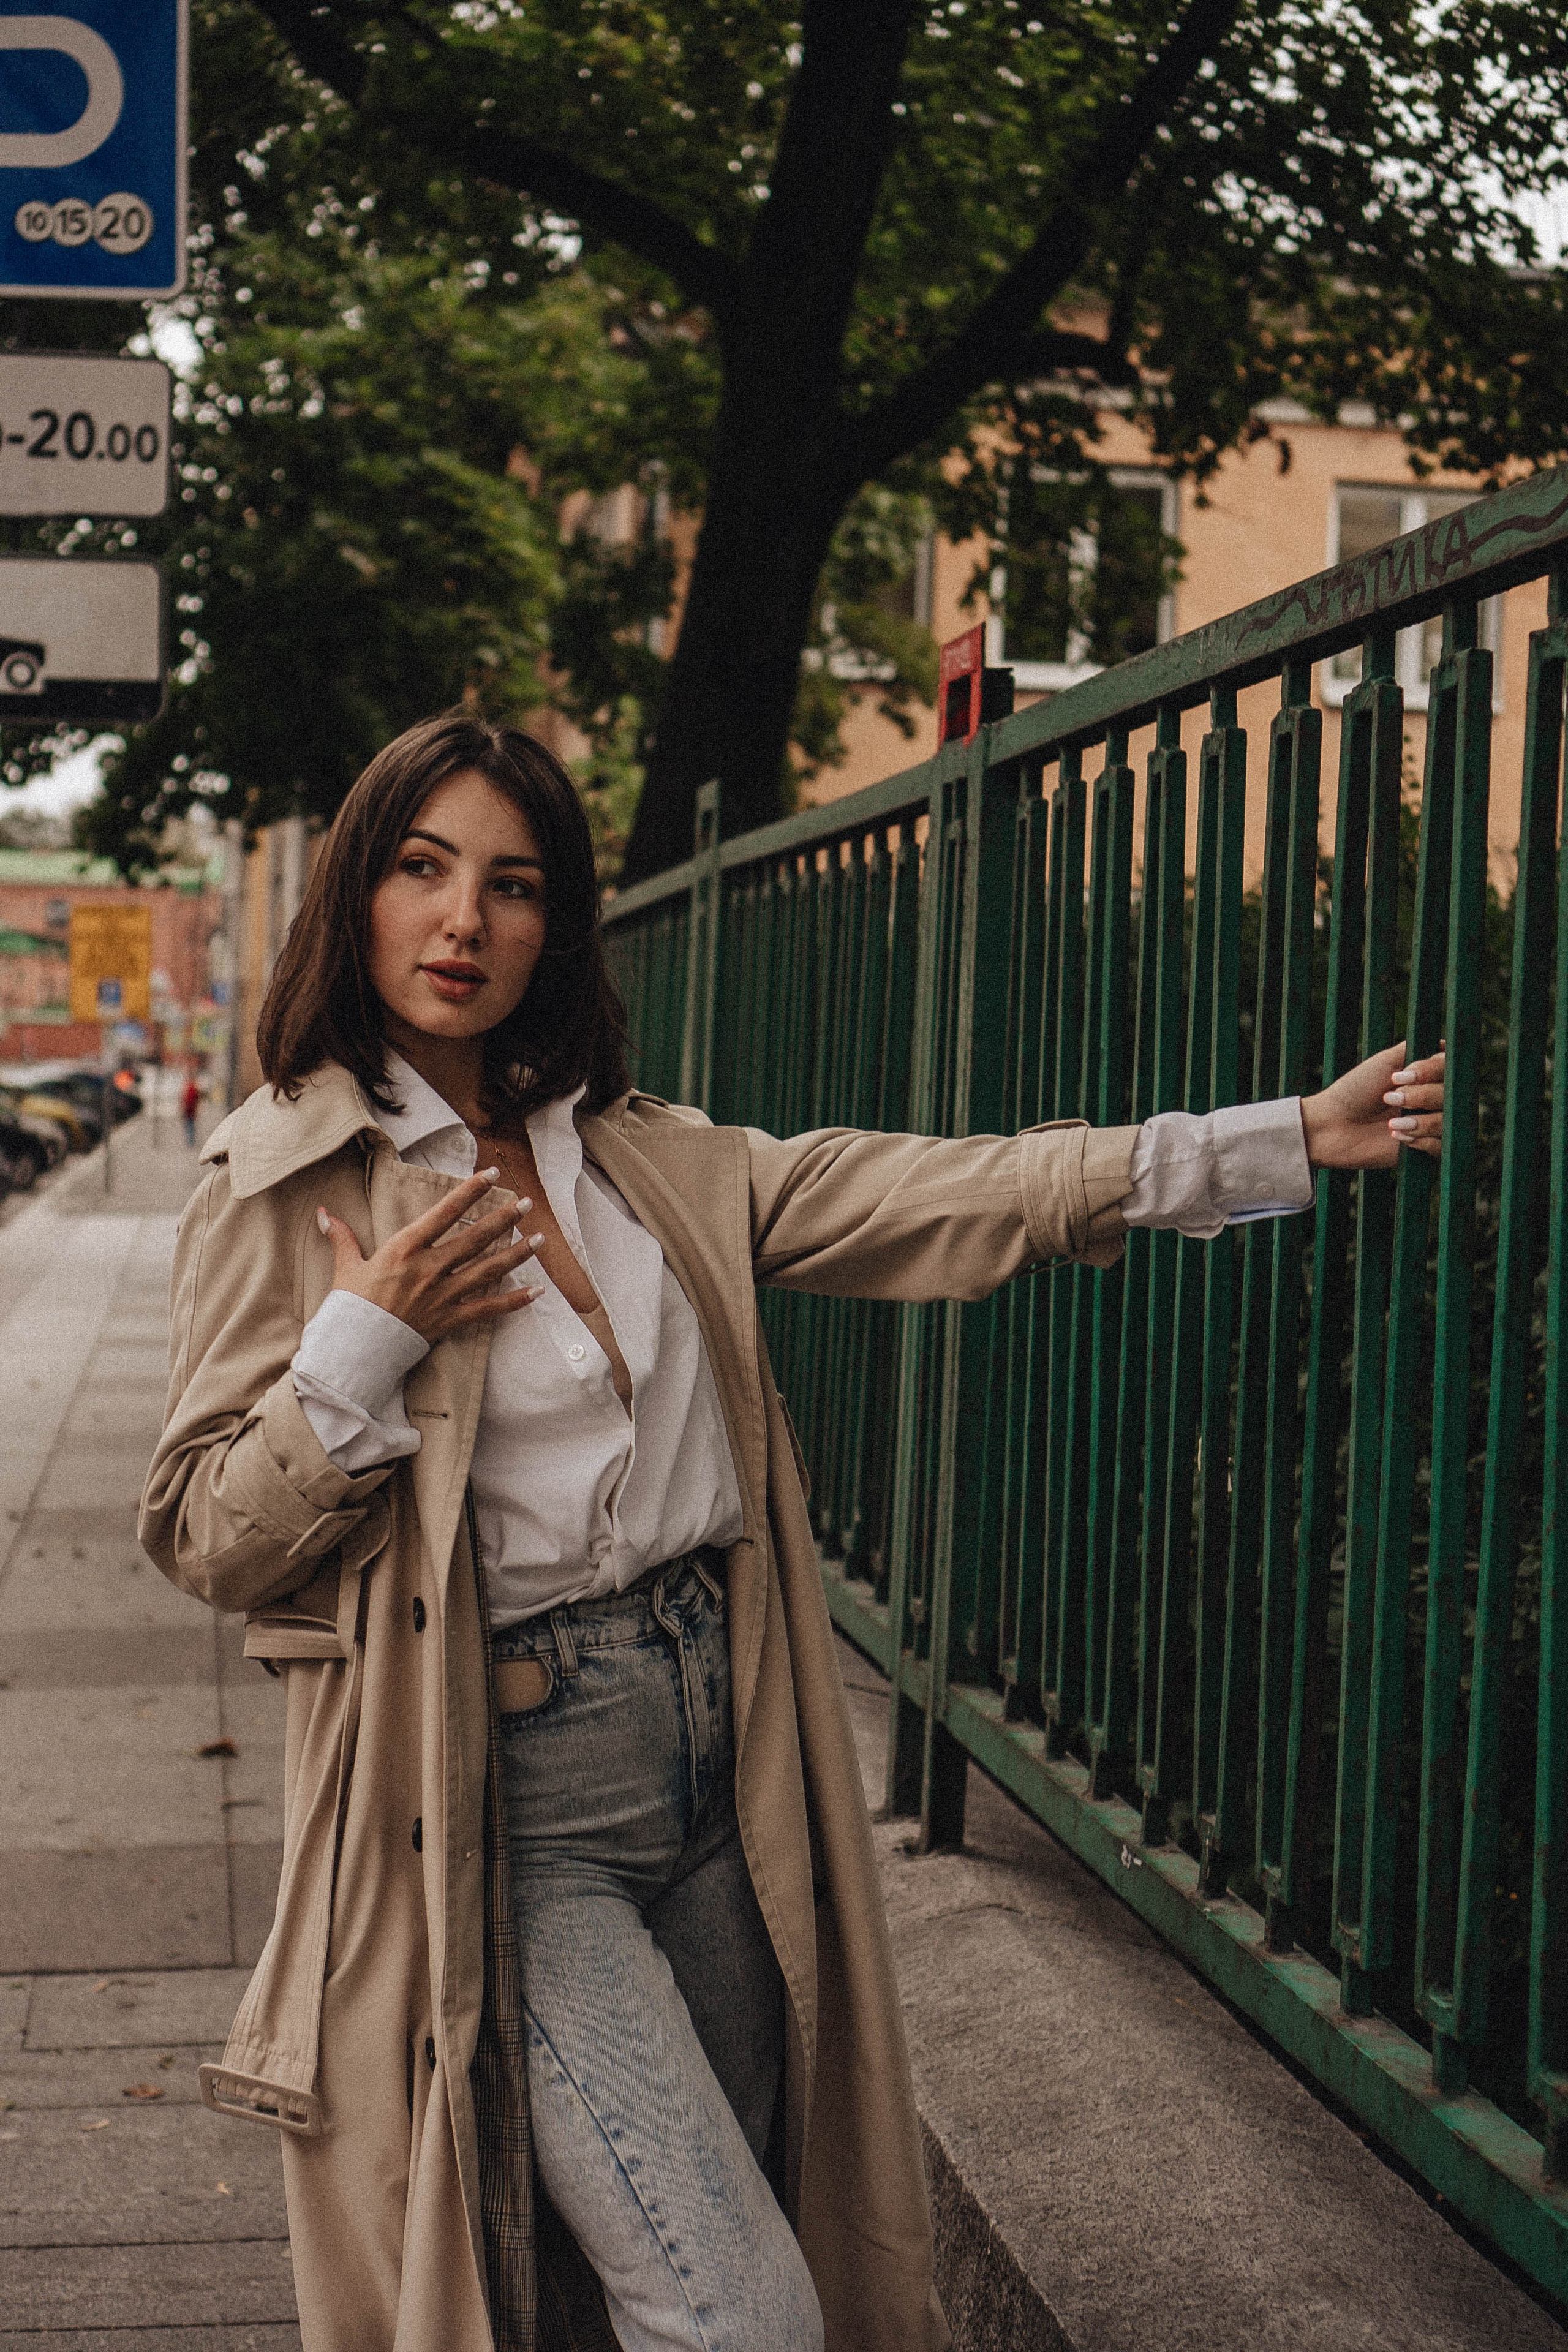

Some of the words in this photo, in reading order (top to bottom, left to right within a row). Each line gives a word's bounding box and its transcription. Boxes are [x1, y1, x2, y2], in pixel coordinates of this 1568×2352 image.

[26, 211, 46, 232] 10
[59, 209, 87, 235] 15
[100, 206, 145, 238] 20
[0, 409, 159, 462] -20.00
